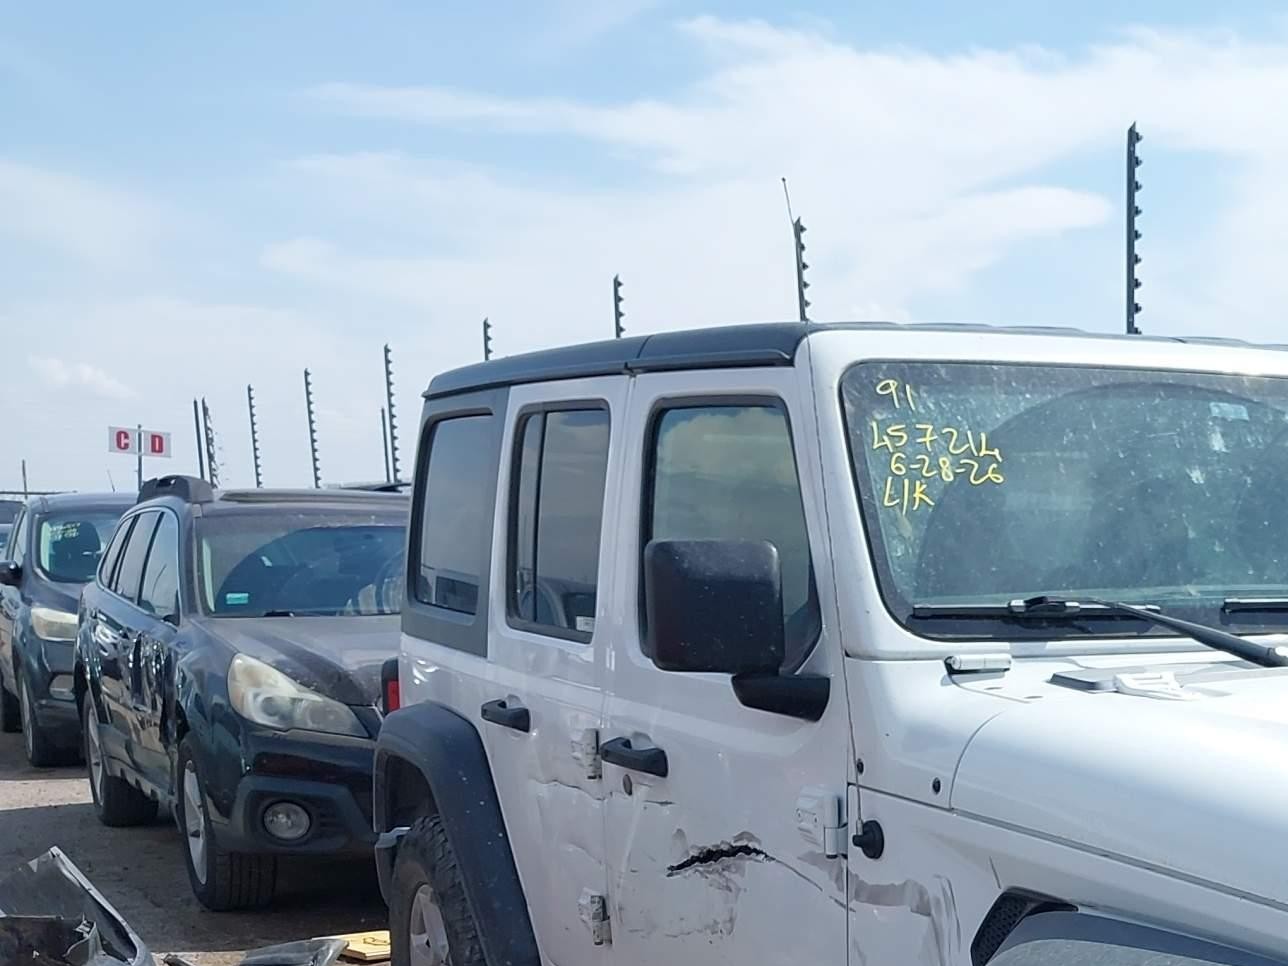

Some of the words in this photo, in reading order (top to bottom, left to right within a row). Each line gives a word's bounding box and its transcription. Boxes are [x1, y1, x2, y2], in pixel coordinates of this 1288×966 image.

[876, 379, 916, 411] 91
[116, 430, 130, 451] C
[150, 433, 164, 454] D
[890, 452, 1004, 485] 6-28-26
